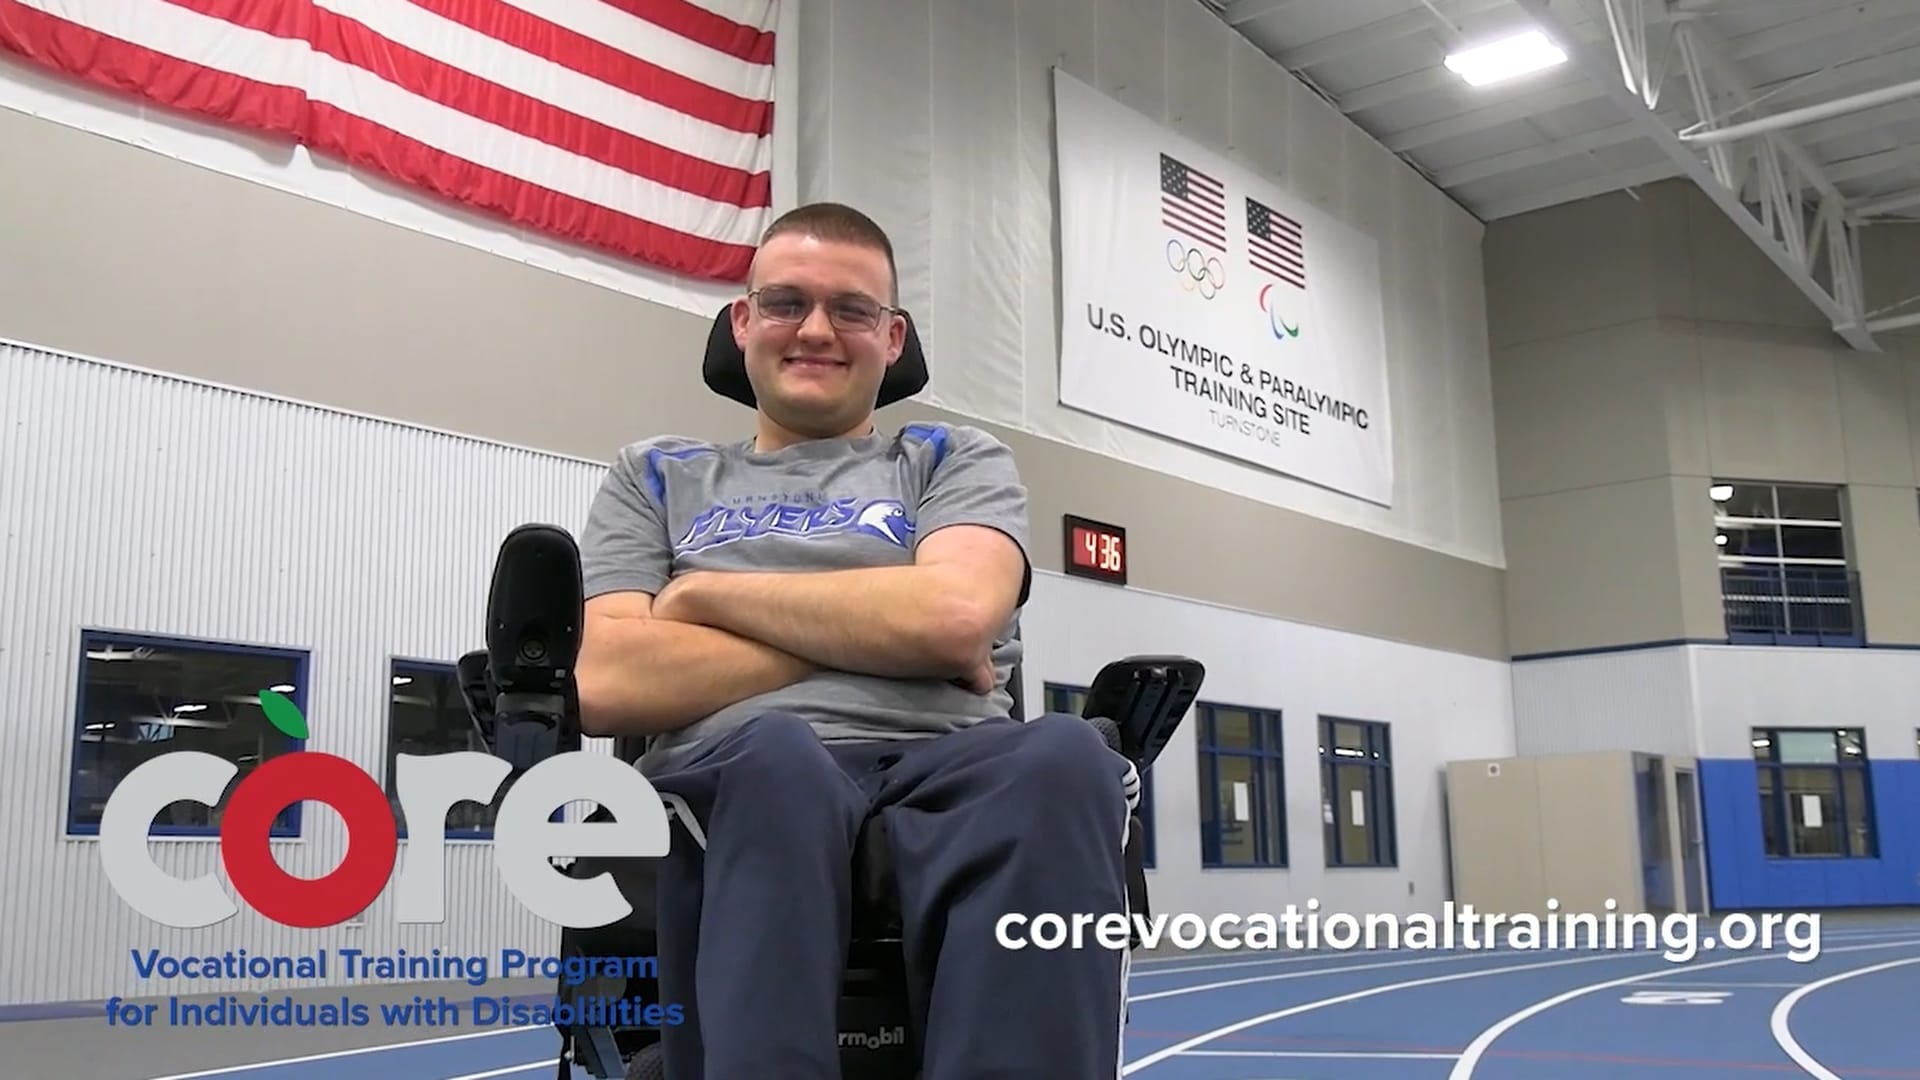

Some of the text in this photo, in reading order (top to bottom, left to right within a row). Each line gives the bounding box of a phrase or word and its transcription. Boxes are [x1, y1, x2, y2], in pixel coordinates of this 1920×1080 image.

[1087, 303, 1369, 430] U.S. OLYMPIC & PARALYMPIC
[1170, 365, 1311, 435] TRAINING SITE
[1208, 409, 1281, 447] TURNSTONE
[838, 1026, 905, 1049] rmobil
